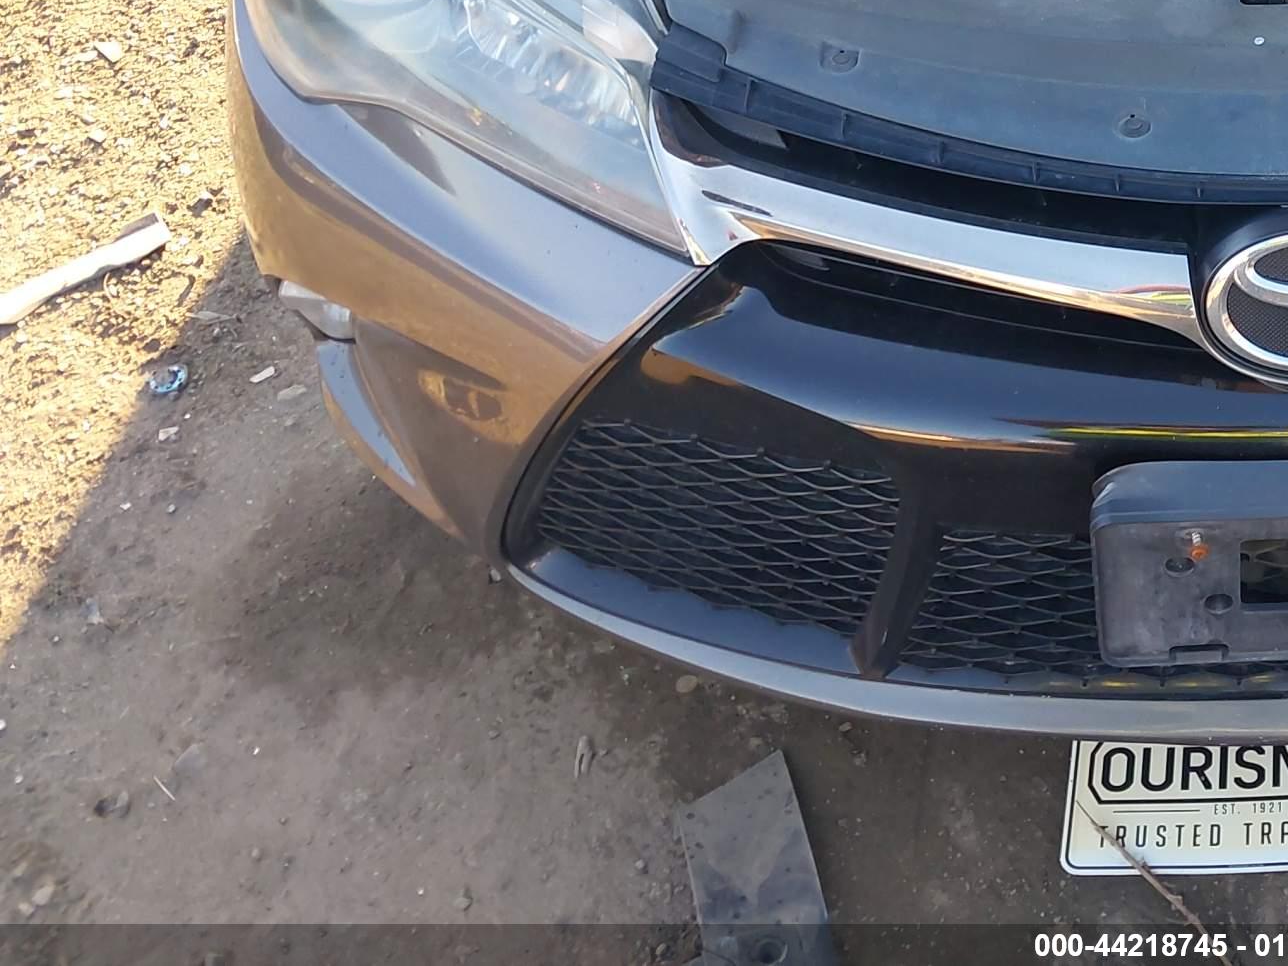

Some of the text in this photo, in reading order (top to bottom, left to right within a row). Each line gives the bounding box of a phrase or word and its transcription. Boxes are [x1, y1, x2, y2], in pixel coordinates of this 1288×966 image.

[1214, 801, 1282, 815] EST. 1921
[1099, 823, 1221, 848] TRUSTED
